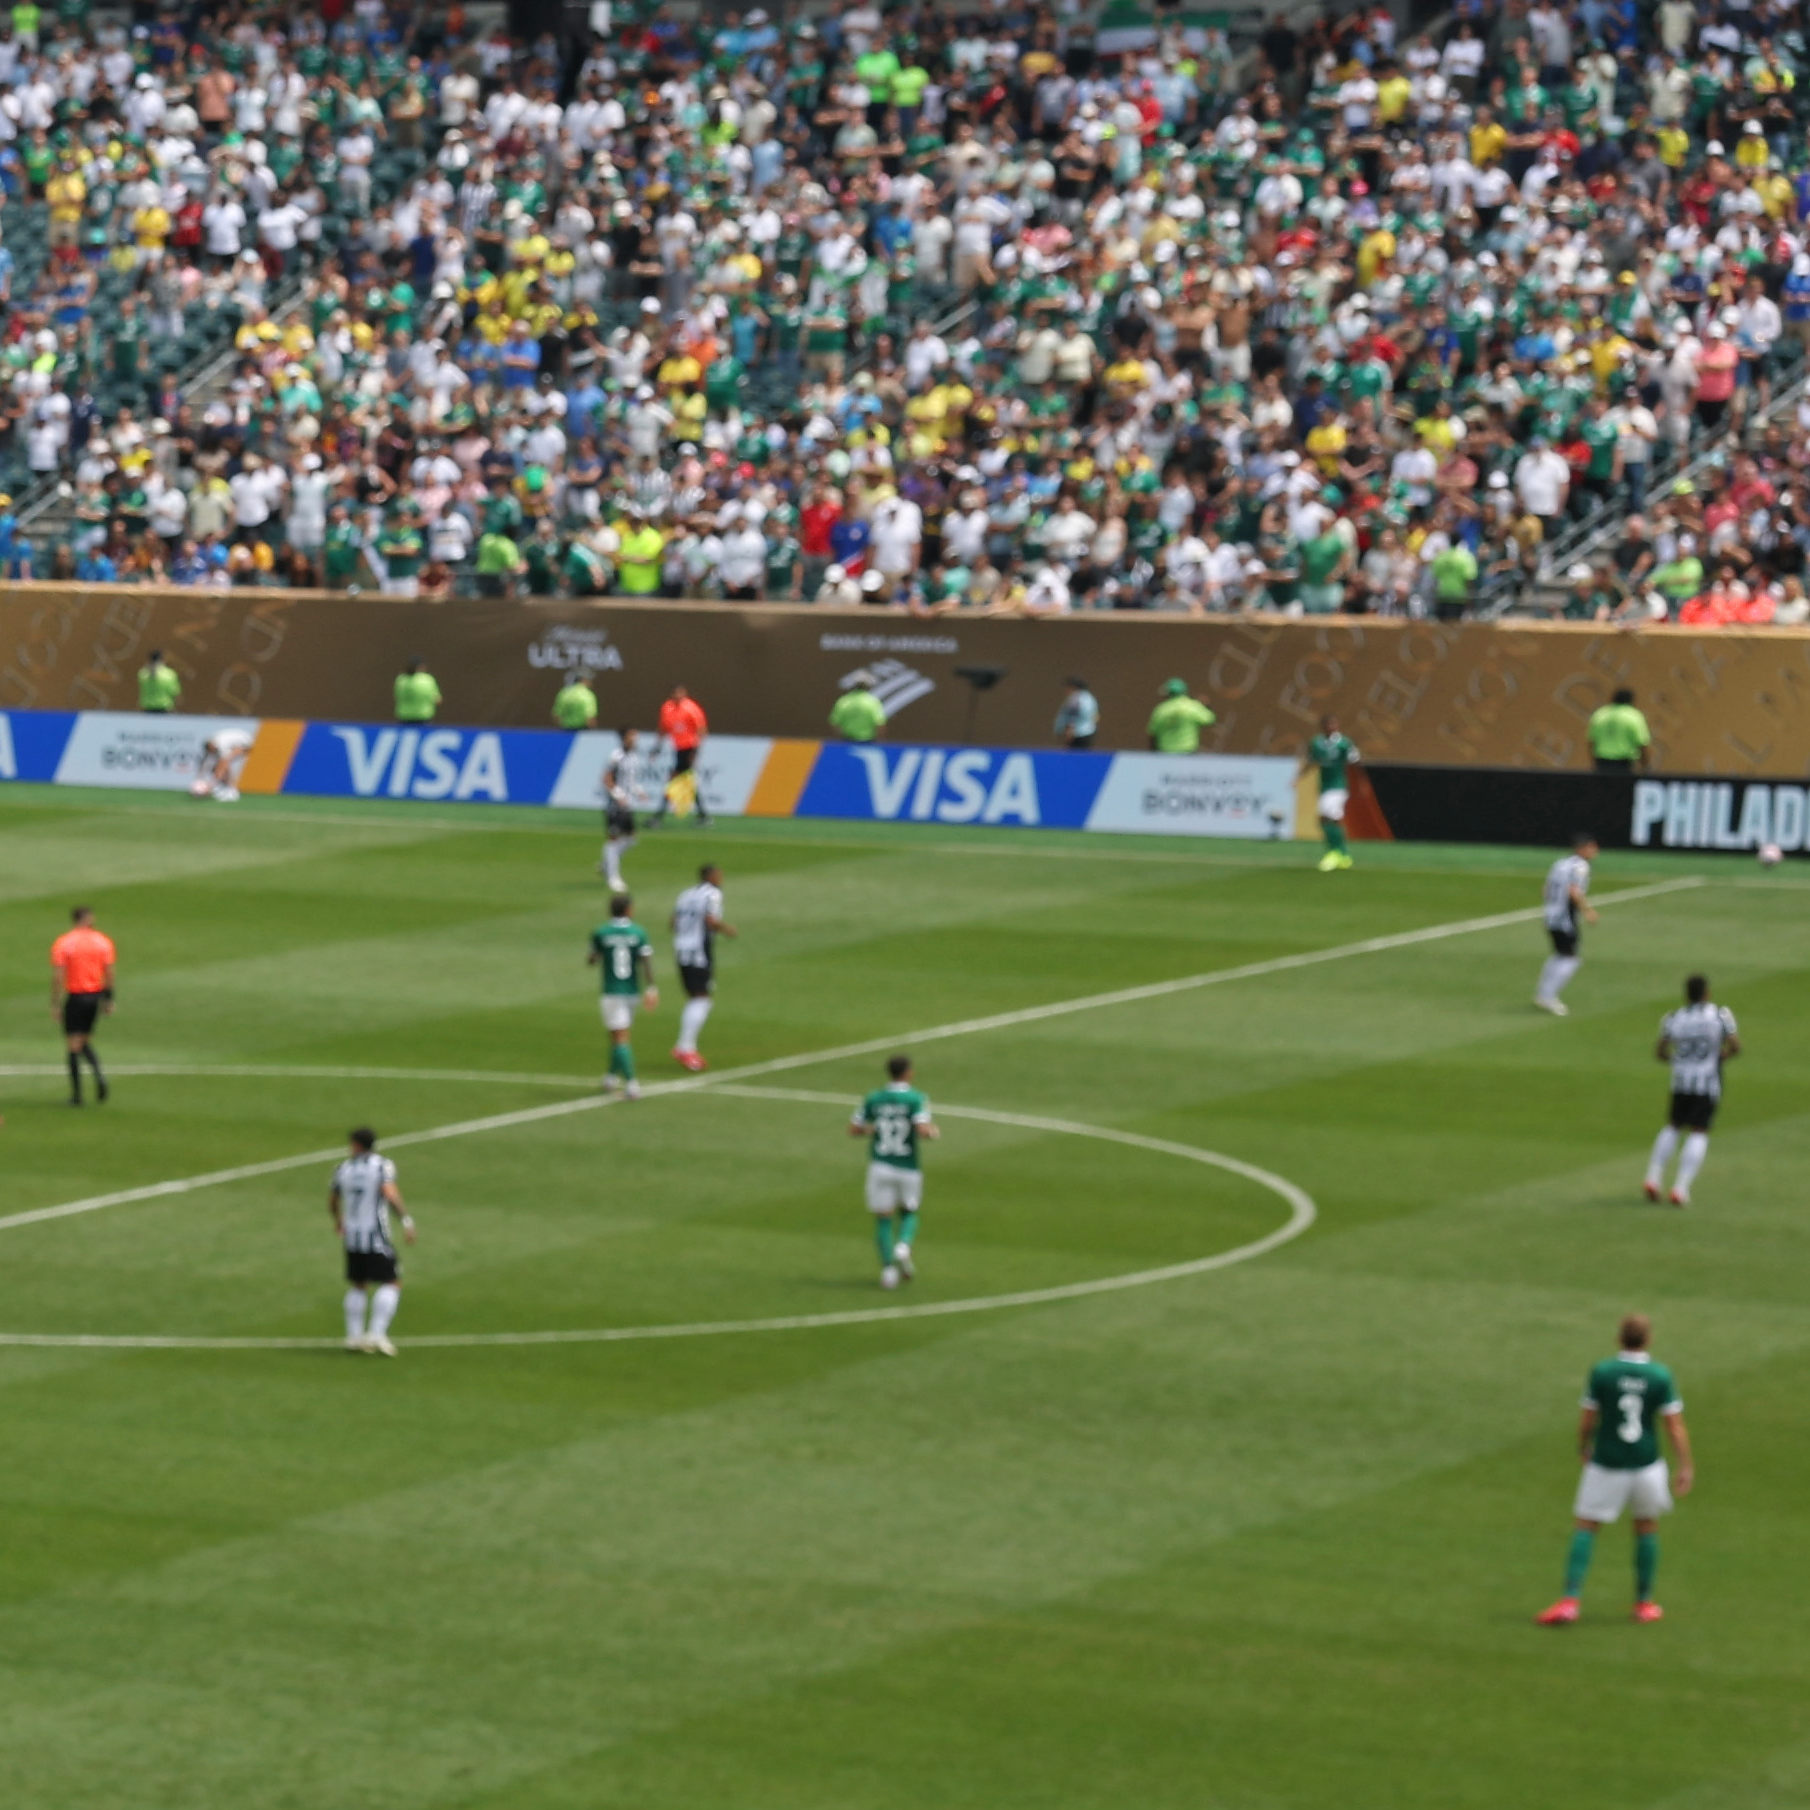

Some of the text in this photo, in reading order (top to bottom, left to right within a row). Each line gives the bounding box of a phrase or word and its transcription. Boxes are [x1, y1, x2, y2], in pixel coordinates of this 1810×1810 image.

[332, 725, 510, 801] VISA
[848, 745, 1042, 827] VISA
[1630, 779, 1810, 851] PHILAD
